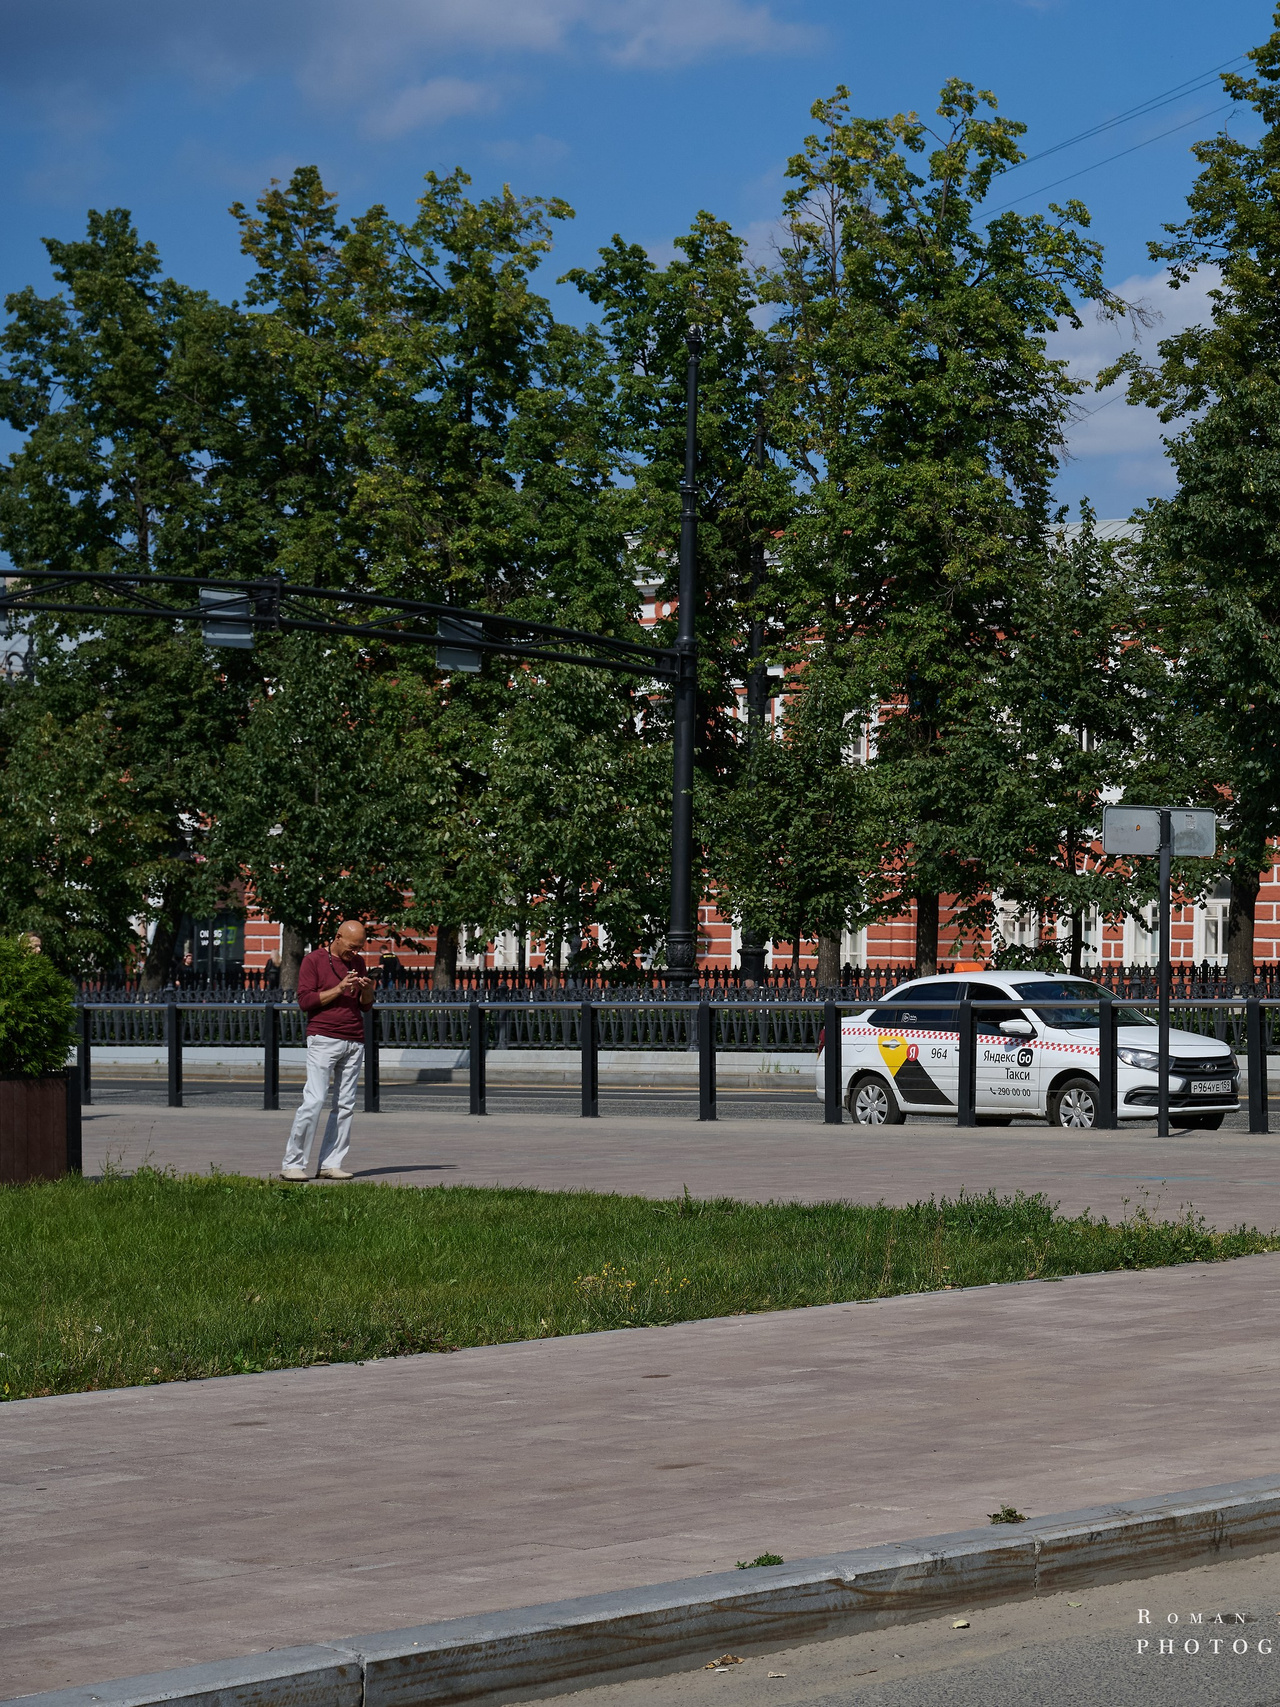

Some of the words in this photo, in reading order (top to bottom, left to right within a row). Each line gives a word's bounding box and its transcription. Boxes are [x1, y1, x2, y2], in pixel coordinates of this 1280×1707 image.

[930, 1047, 948, 1060] 964
[983, 1050, 1016, 1064] Яндекс
[1018, 1051, 1032, 1064] Go
[1004, 1067, 1030, 1081] Такси
[997, 1087, 1010, 1096] 290
[1011, 1088, 1021, 1097] 00
[1022, 1088, 1031, 1097] 00
